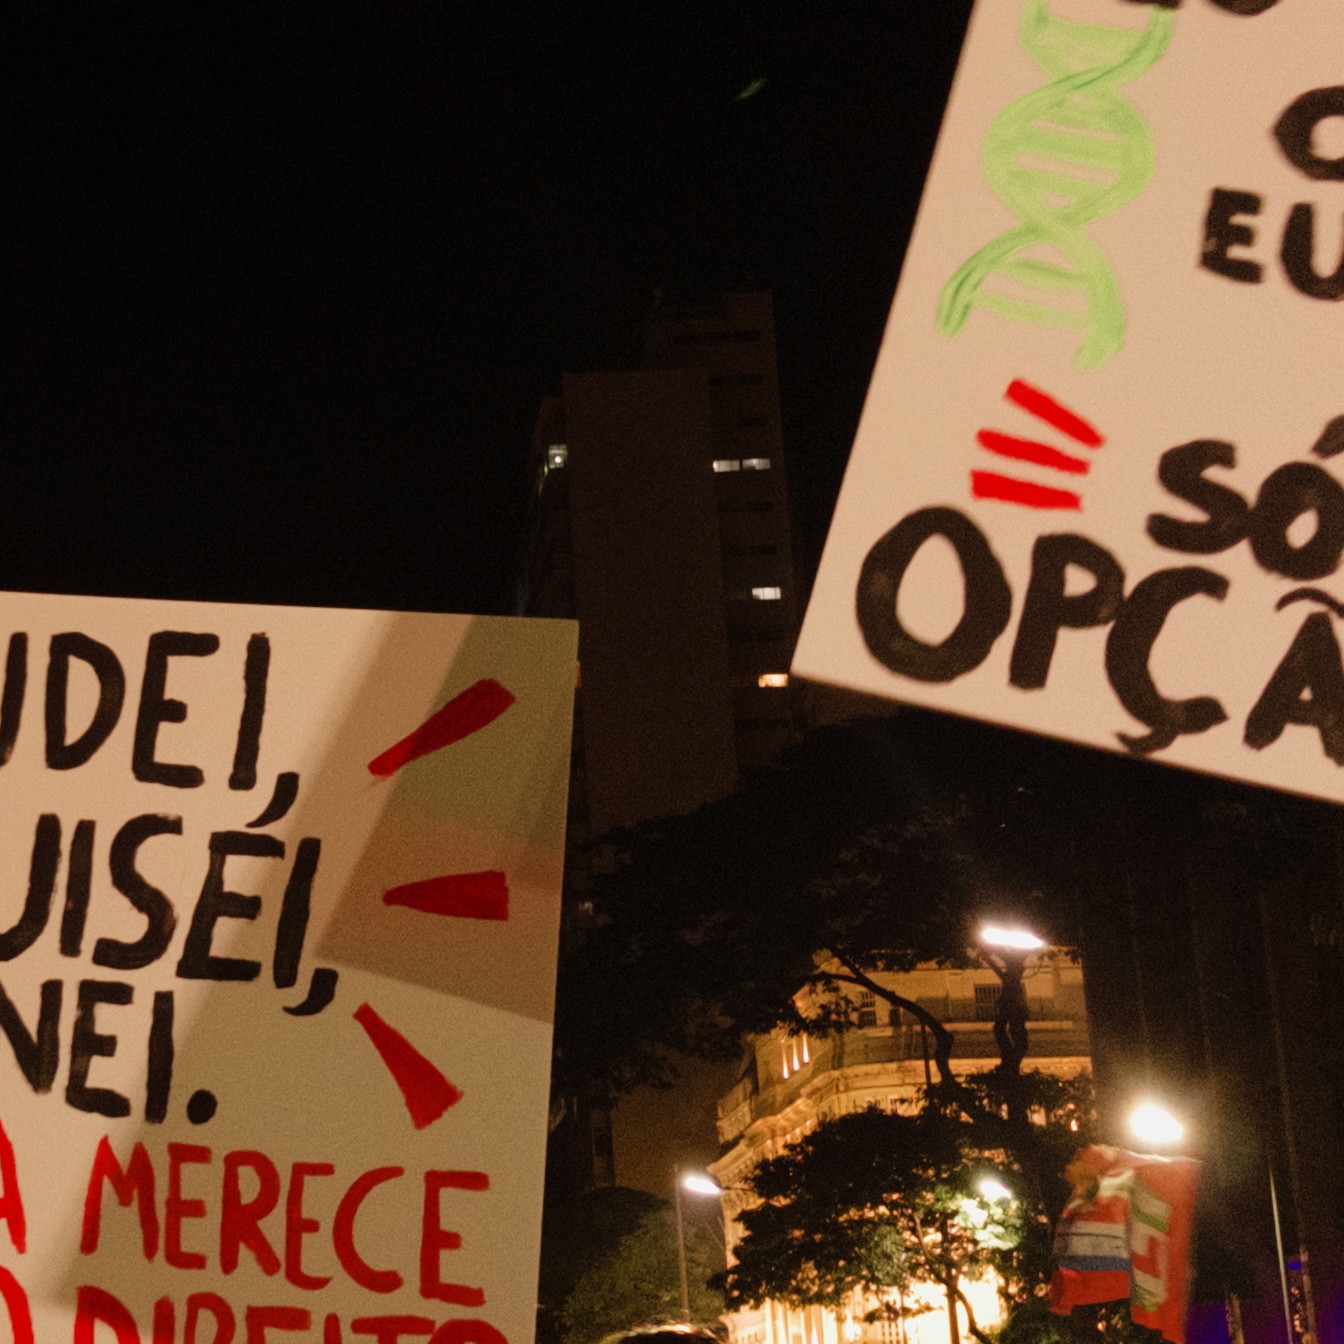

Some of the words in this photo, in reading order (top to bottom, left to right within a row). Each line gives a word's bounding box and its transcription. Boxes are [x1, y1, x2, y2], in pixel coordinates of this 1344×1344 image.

[1199, 187, 1344, 301] EU
[1145, 414, 1344, 581] SÓ
[79, 1134, 491, 1309] MERECE
